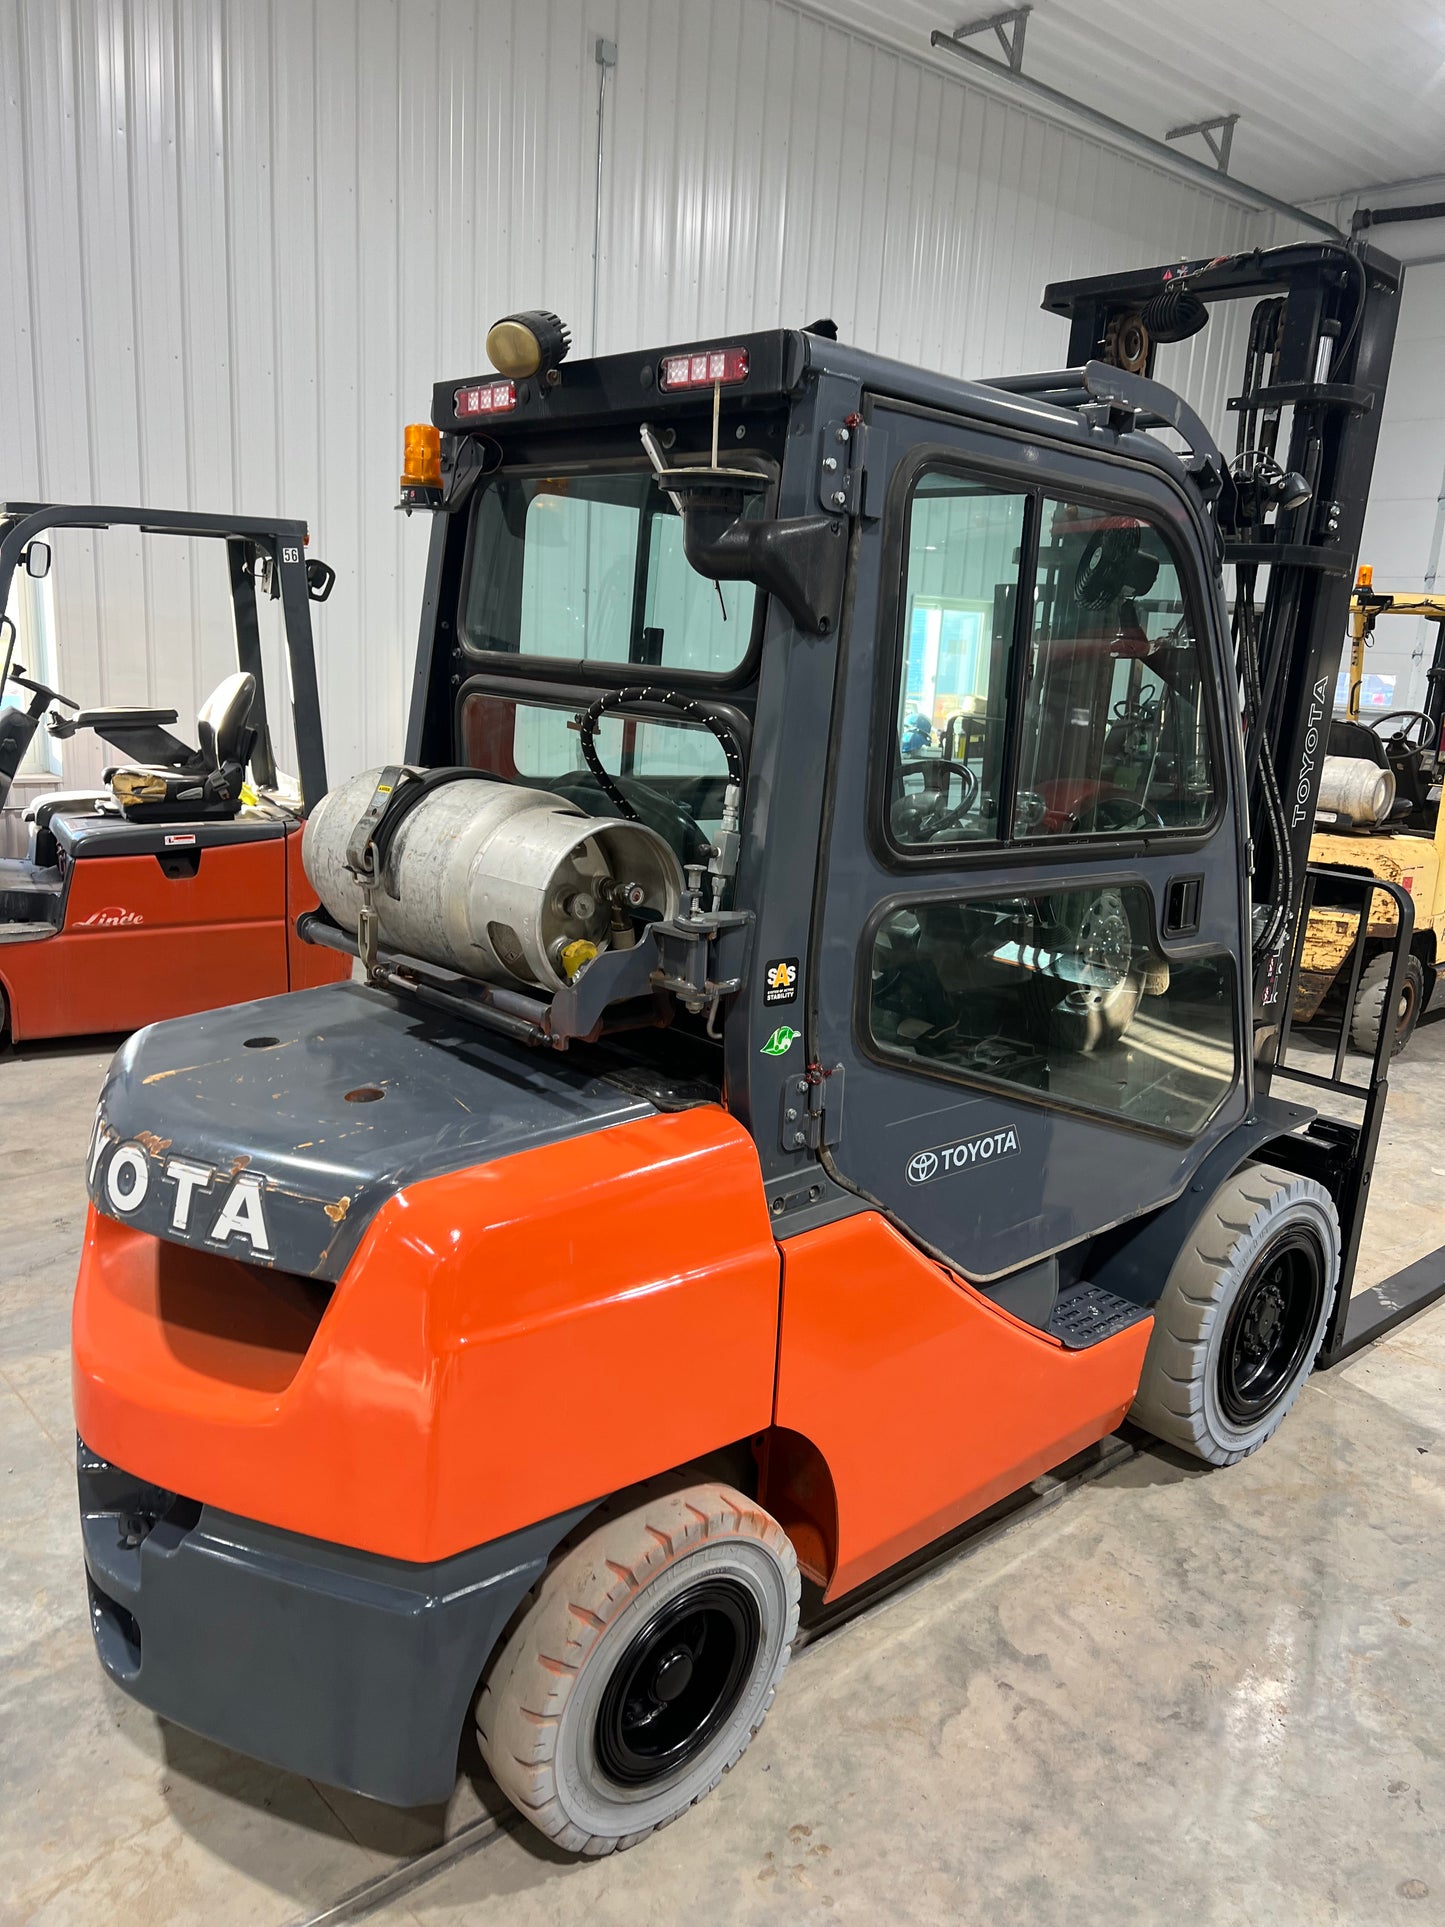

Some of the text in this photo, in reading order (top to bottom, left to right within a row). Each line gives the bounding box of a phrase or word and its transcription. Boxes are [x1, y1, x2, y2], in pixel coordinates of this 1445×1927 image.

[284, 548, 298, 562] 56
[1291, 675, 1329, 828] TOYOTA
[71, 906, 144, 927] Linde
[767, 963, 797, 988] SAS
[766, 991, 795, 1001] STABILITY
[941, 1130, 1017, 1170] TOYOTA
[88, 1102, 270, 1251] YOTA
